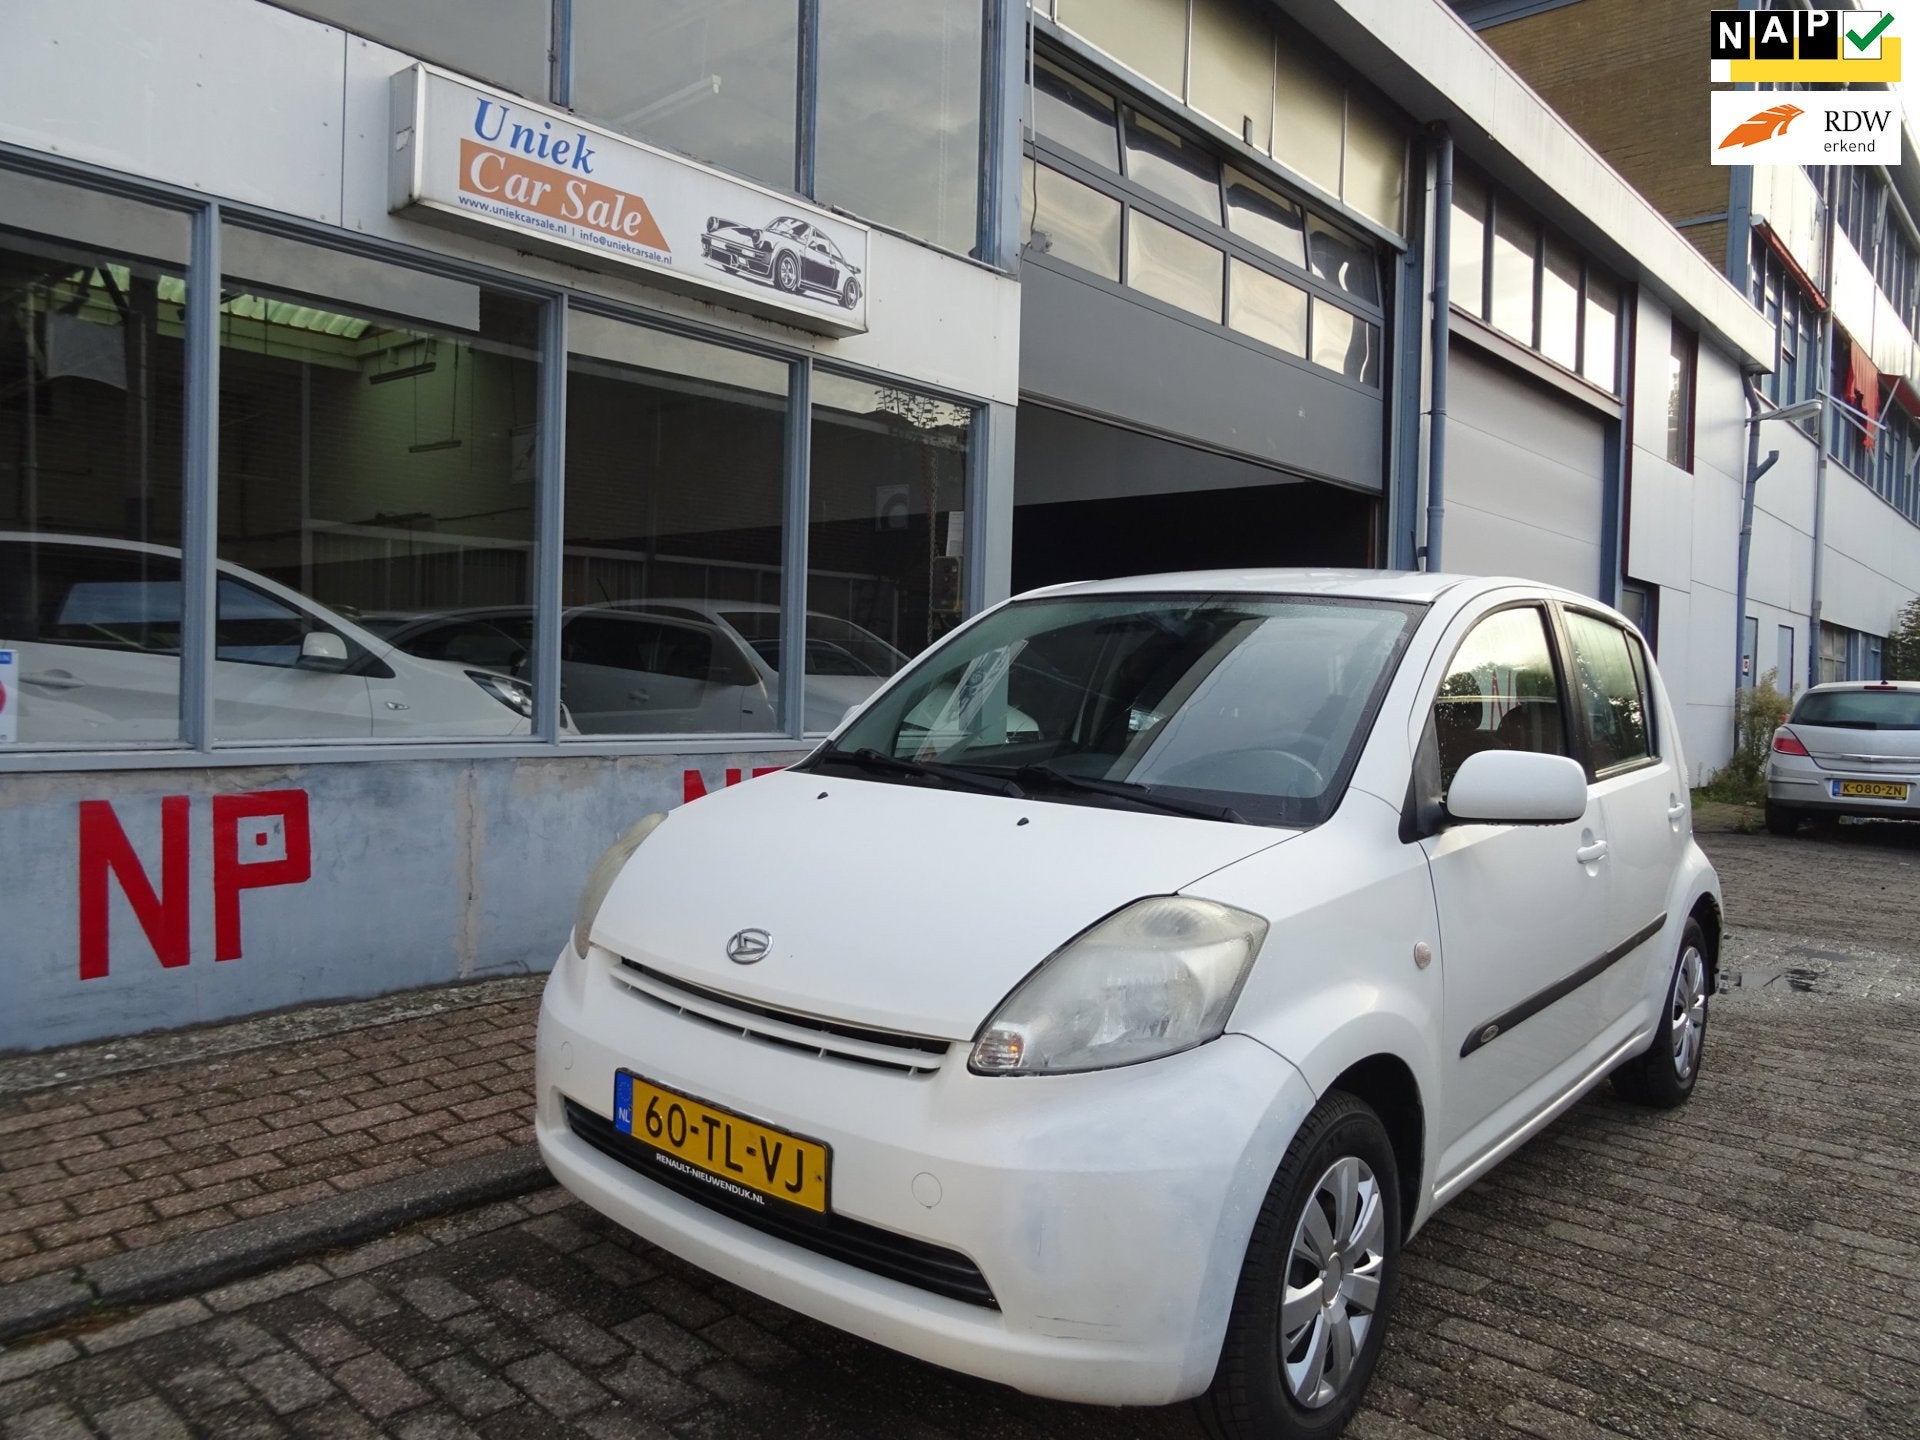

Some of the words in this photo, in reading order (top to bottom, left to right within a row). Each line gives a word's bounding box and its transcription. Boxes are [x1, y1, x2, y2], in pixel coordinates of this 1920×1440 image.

[474, 97, 596, 174] Uniek
[458, 195, 567, 234] www.uniekcarsale.nl
[579, 229, 673, 265] info@uniekcarsale.nl
[470, 151, 552, 207] Car
[561, 180, 642, 237] Sale
[1842, 783, 1903, 796] K-080-ZN
[79, 788, 312, 981] NP
[618, 1107, 631, 1124] NL
[645, 1095, 804, 1194] 60-TL-VJ
[655, 1153, 766, 1206] RENAULT-NIEUWENDIJK.NL
